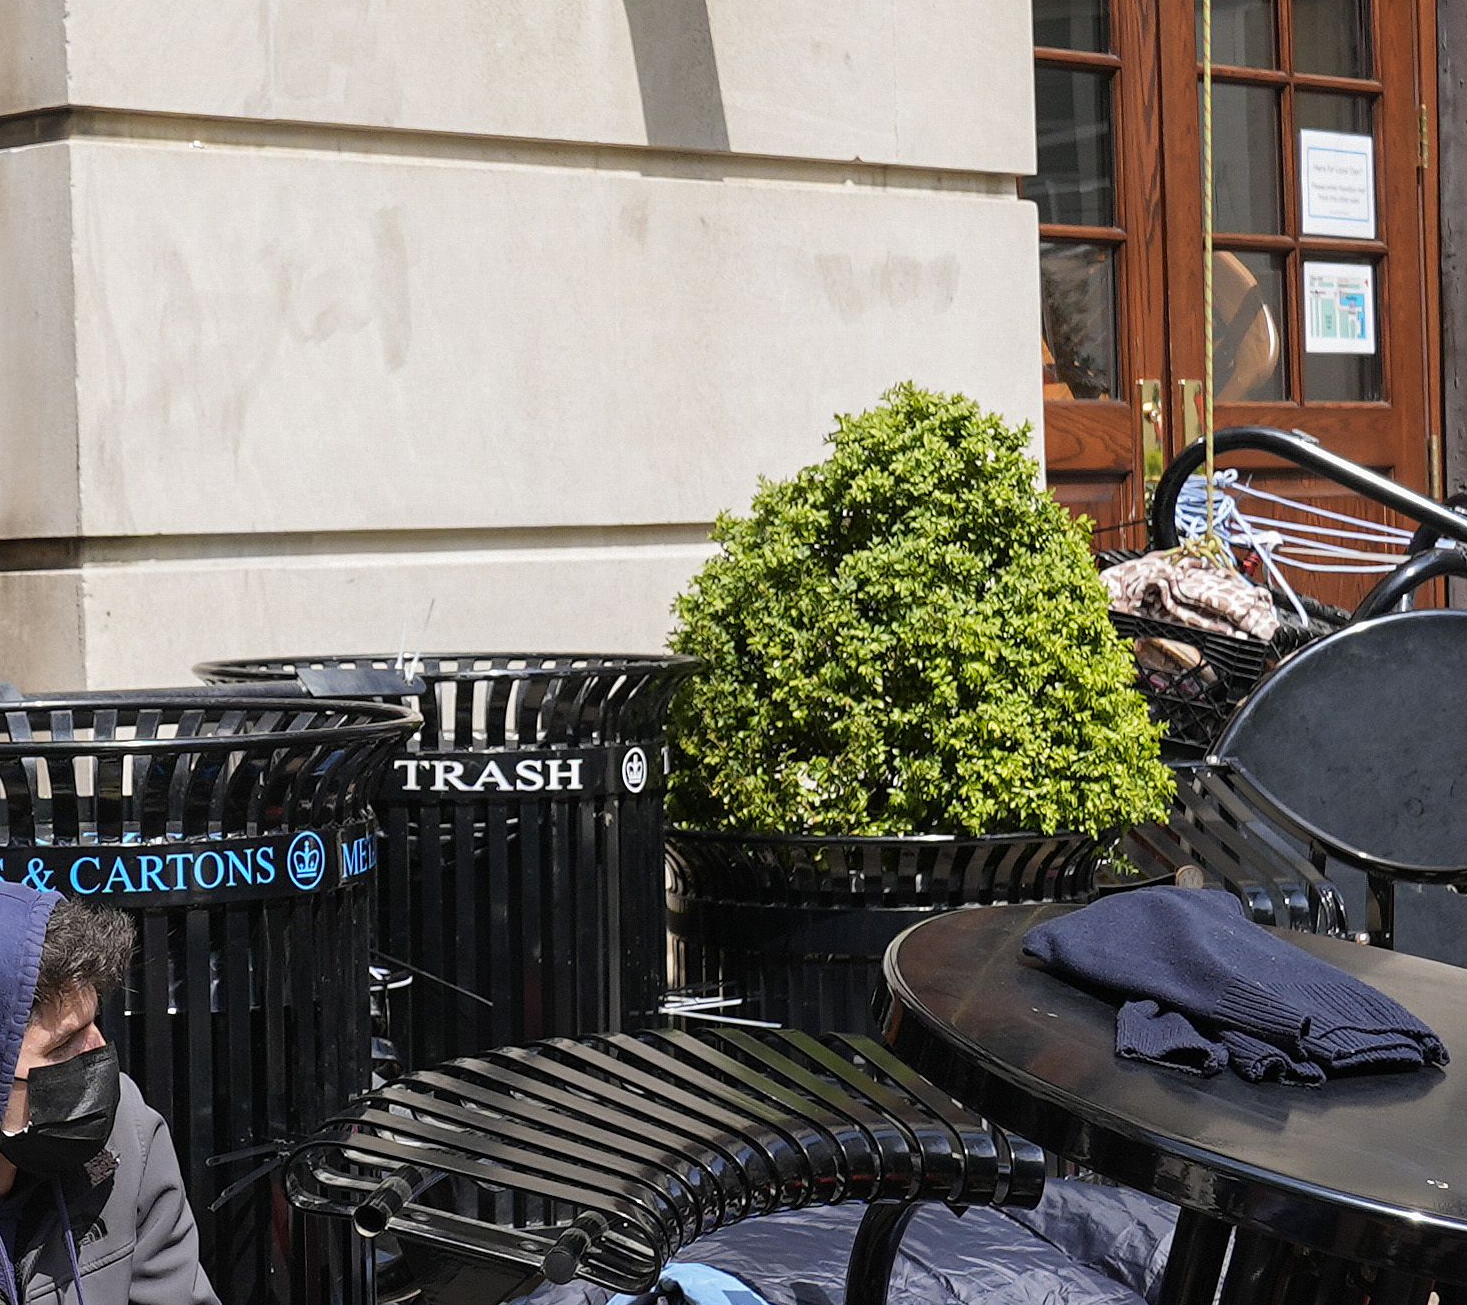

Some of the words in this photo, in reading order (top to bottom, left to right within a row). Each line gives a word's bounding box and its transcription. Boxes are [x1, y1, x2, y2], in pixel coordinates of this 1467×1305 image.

[393, 758, 584, 791] TRASH
[22, 859, 57, 893] &
[69, 846, 277, 894] CARTONS
